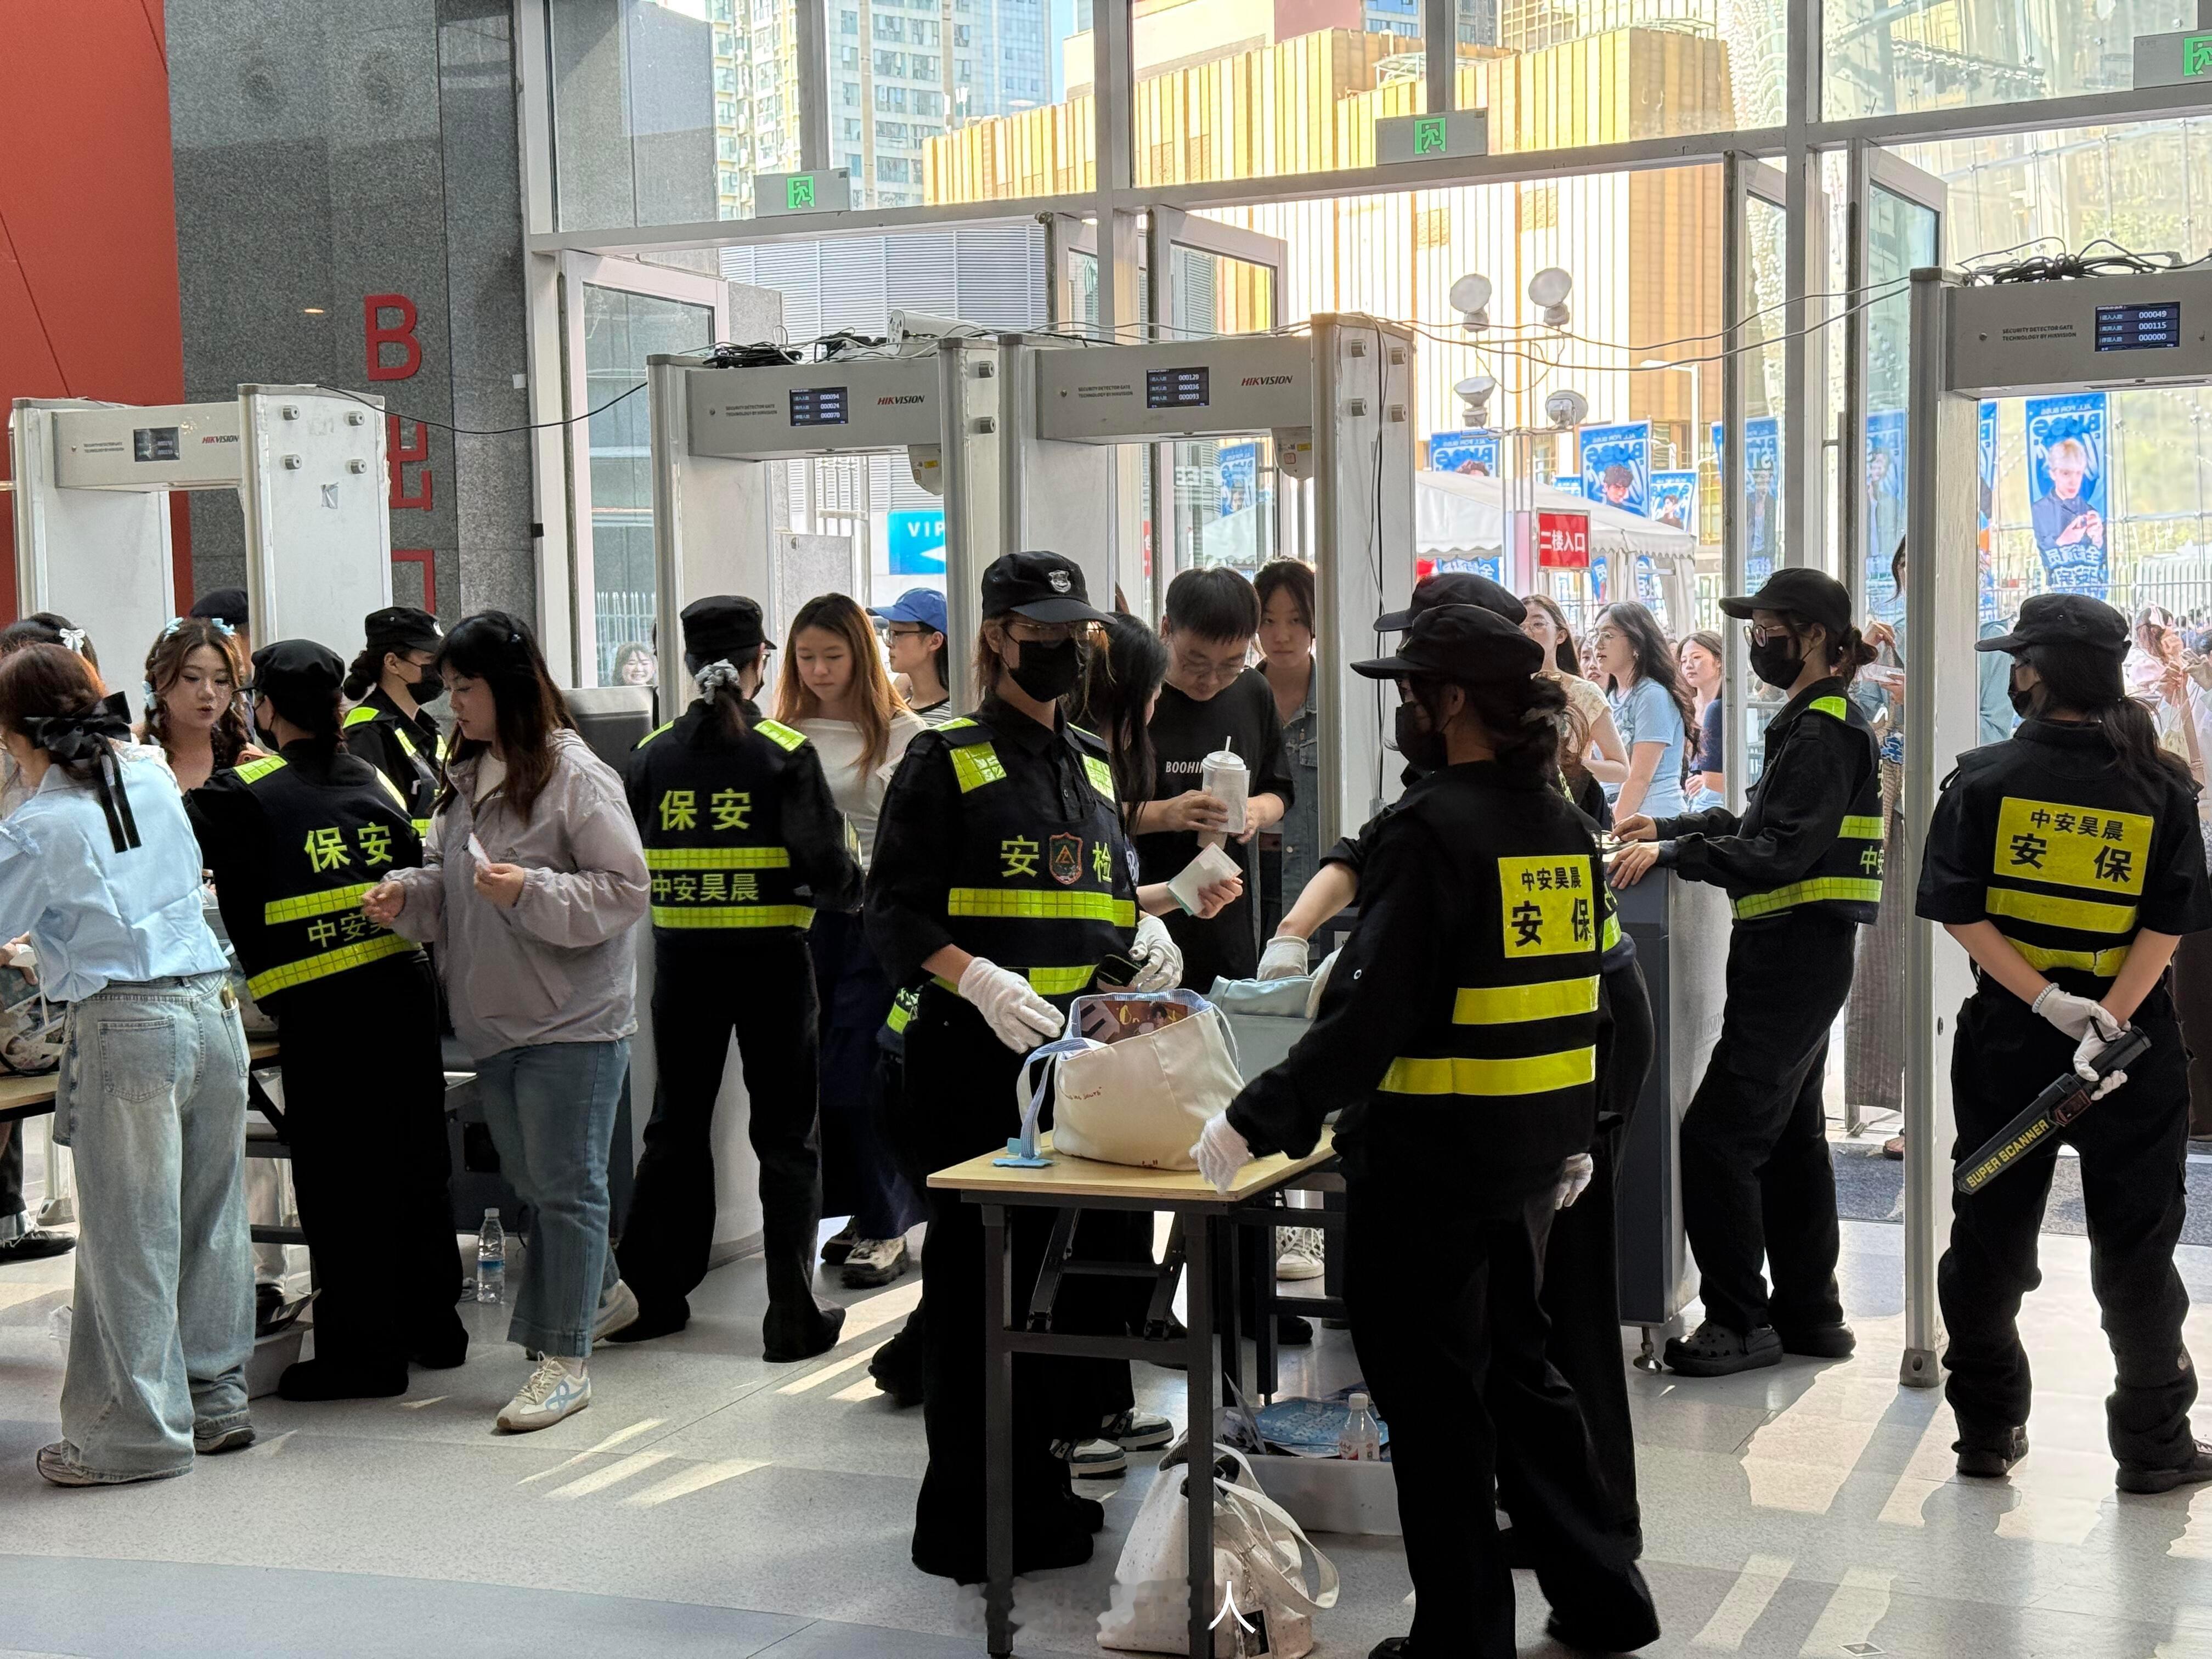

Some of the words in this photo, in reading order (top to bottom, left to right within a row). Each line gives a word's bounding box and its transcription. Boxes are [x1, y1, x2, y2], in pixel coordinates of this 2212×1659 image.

[2138, 321, 2166, 330] 000115
[2139, 311, 2167, 319] 000049
[2138, 333, 2166, 341] 000000
[1242, 375, 1293, 386] HIKVISION
[877, 395, 925, 405] HIKVISION
[202, 435, 239, 444] HIKVISION
[907, 522, 945, 537] VIP
[1541, 529, 1585, 553] 二楼入口
[659, 788, 752, 831] 保安
[2030, 809, 2124, 842] 中安昊晨
[304, 822, 393, 873] 保安
[2010, 833, 2132, 883] 安保
[652, 873, 759, 901] 中安昊晨
[1521, 867, 1582, 891] 中安昊晨
[1511, 898, 1591, 947] 安保
[1966, 1159, 2001, 1188] SUPER
[2001, 1119, 2050, 1162] SCANNER
